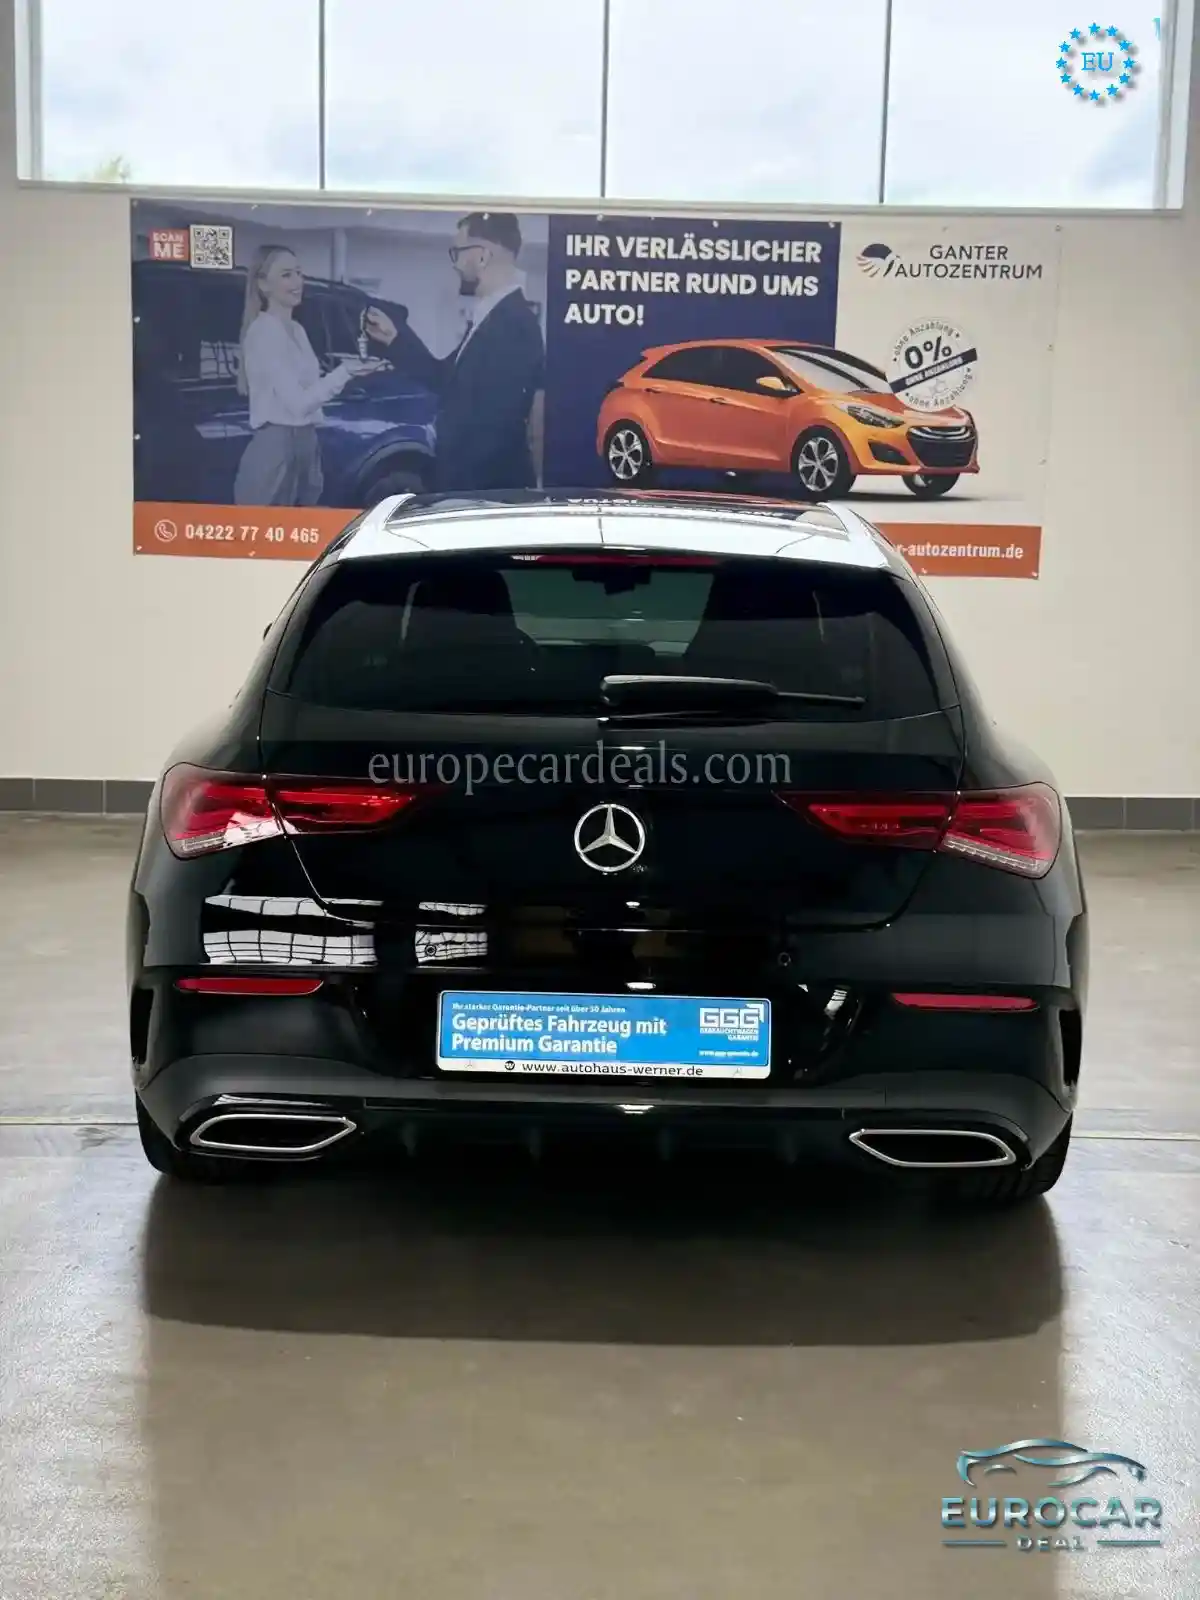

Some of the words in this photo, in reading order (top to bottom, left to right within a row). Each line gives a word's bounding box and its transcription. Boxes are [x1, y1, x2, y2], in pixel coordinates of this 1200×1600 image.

[152, 231, 184, 242] SCAN
[153, 242, 185, 258] ME
[566, 234, 611, 258] IHR
[616, 233, 822, 263] VERLÄSSLICHER
[929, 244, 1009, 261] GANTER
[895, 263, 1043, 280] AUTOZENTRUM
[565, 269, 680, 294] PARTNER
[685, 272, 757, 296] RUND
[763, 275, 819, 297] UMS
[564, 303, 645, 326] AUTO!
[909, 320, 954, 337] Anzahlung
[904, 335, 952, 369] 0%
[185, 523, 235, 540] 04222
[240, 526, 260, 541] 77
[264, 527, 285, 543] 40
[290, 527, 320, 544] 465
[893, 542, 1024, 559] r-autozentrum.de
[452, 1012, 543, 1034] Geprüftes
[547, 1015, 631, 1038] Fahrzeug
[636, 1018, 667, 1035] mit
[700, 1007, 759, 1028] GGG
[452, 1034, 534, 1051] Premium
[538, 1035, 618, 1053] Garantie
[522, 1061, 704, 1076] www.autohaus-werner.de
